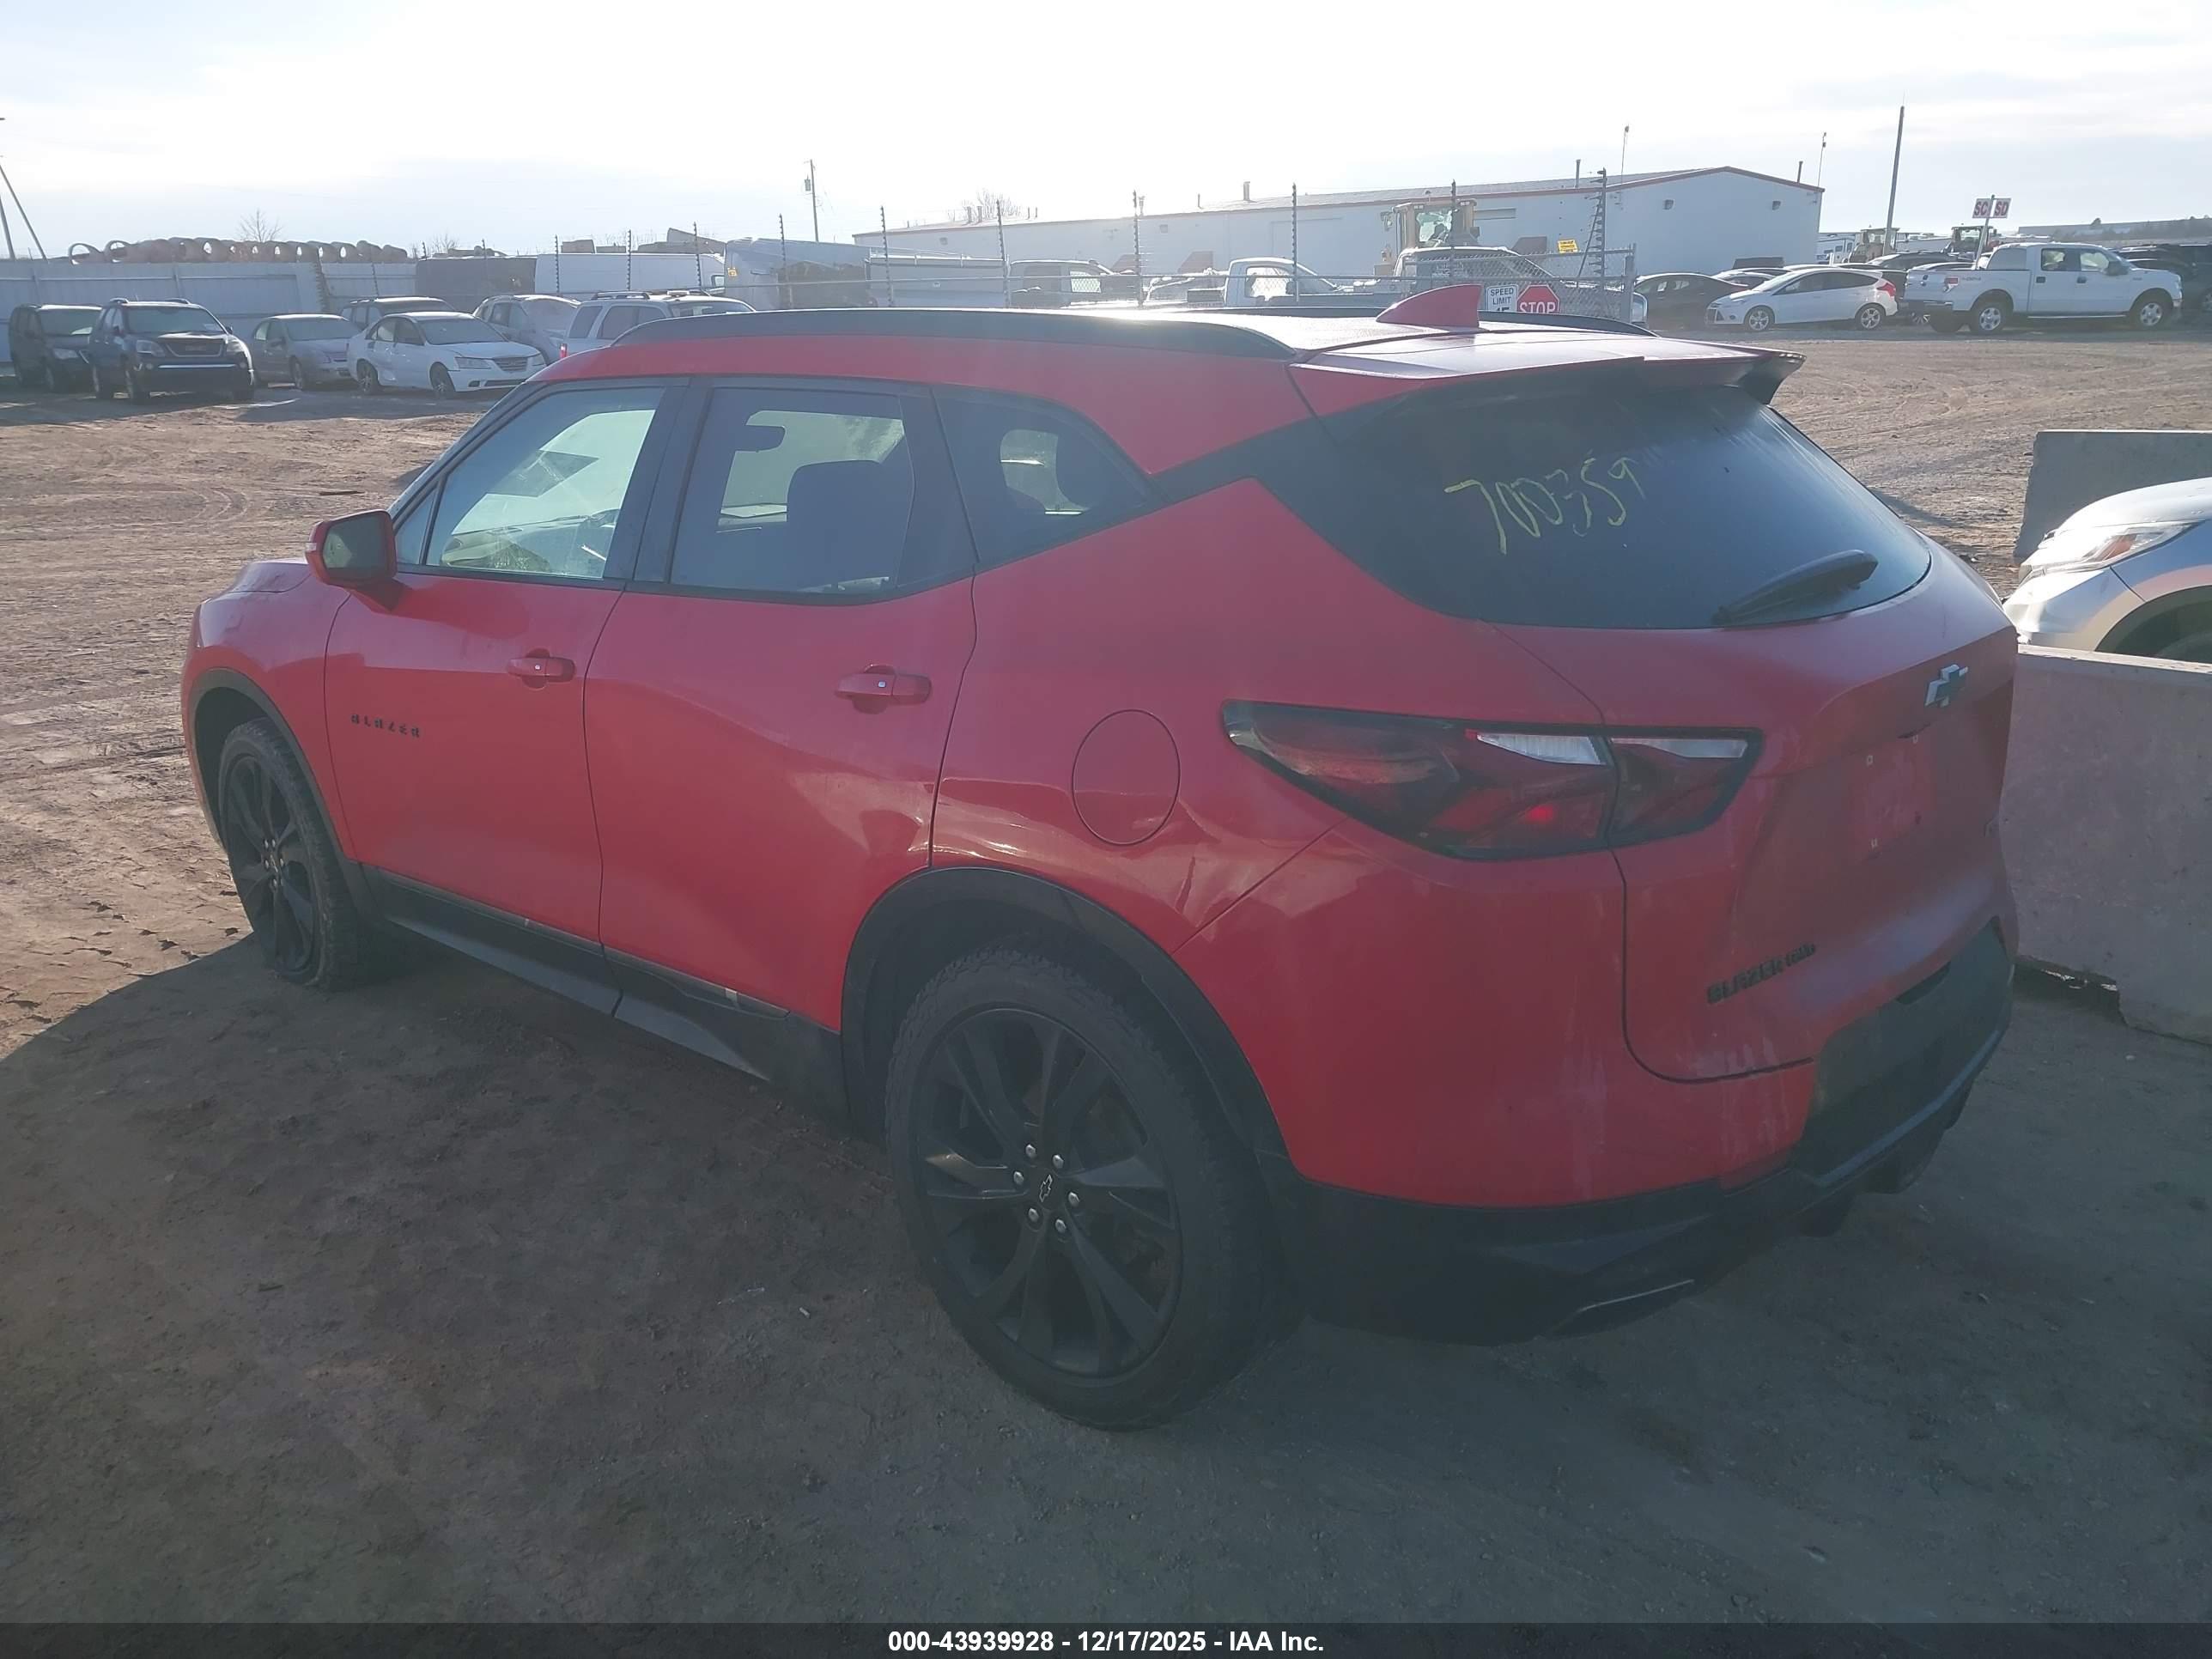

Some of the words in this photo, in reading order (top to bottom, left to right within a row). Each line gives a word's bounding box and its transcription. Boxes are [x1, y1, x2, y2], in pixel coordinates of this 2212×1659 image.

[1974, 201, 1989, 216] SC
[1994, 201, 2010, 216] SD
[1490, 288, 1514, 296] SPEED
[1492, 296, 1511, 305] LIMIT
[1519, 301, 1556, 314] STOP
[350, 714, 420, 738] BLAZER
[1706, 958, 1784, 1004] BLAZER
